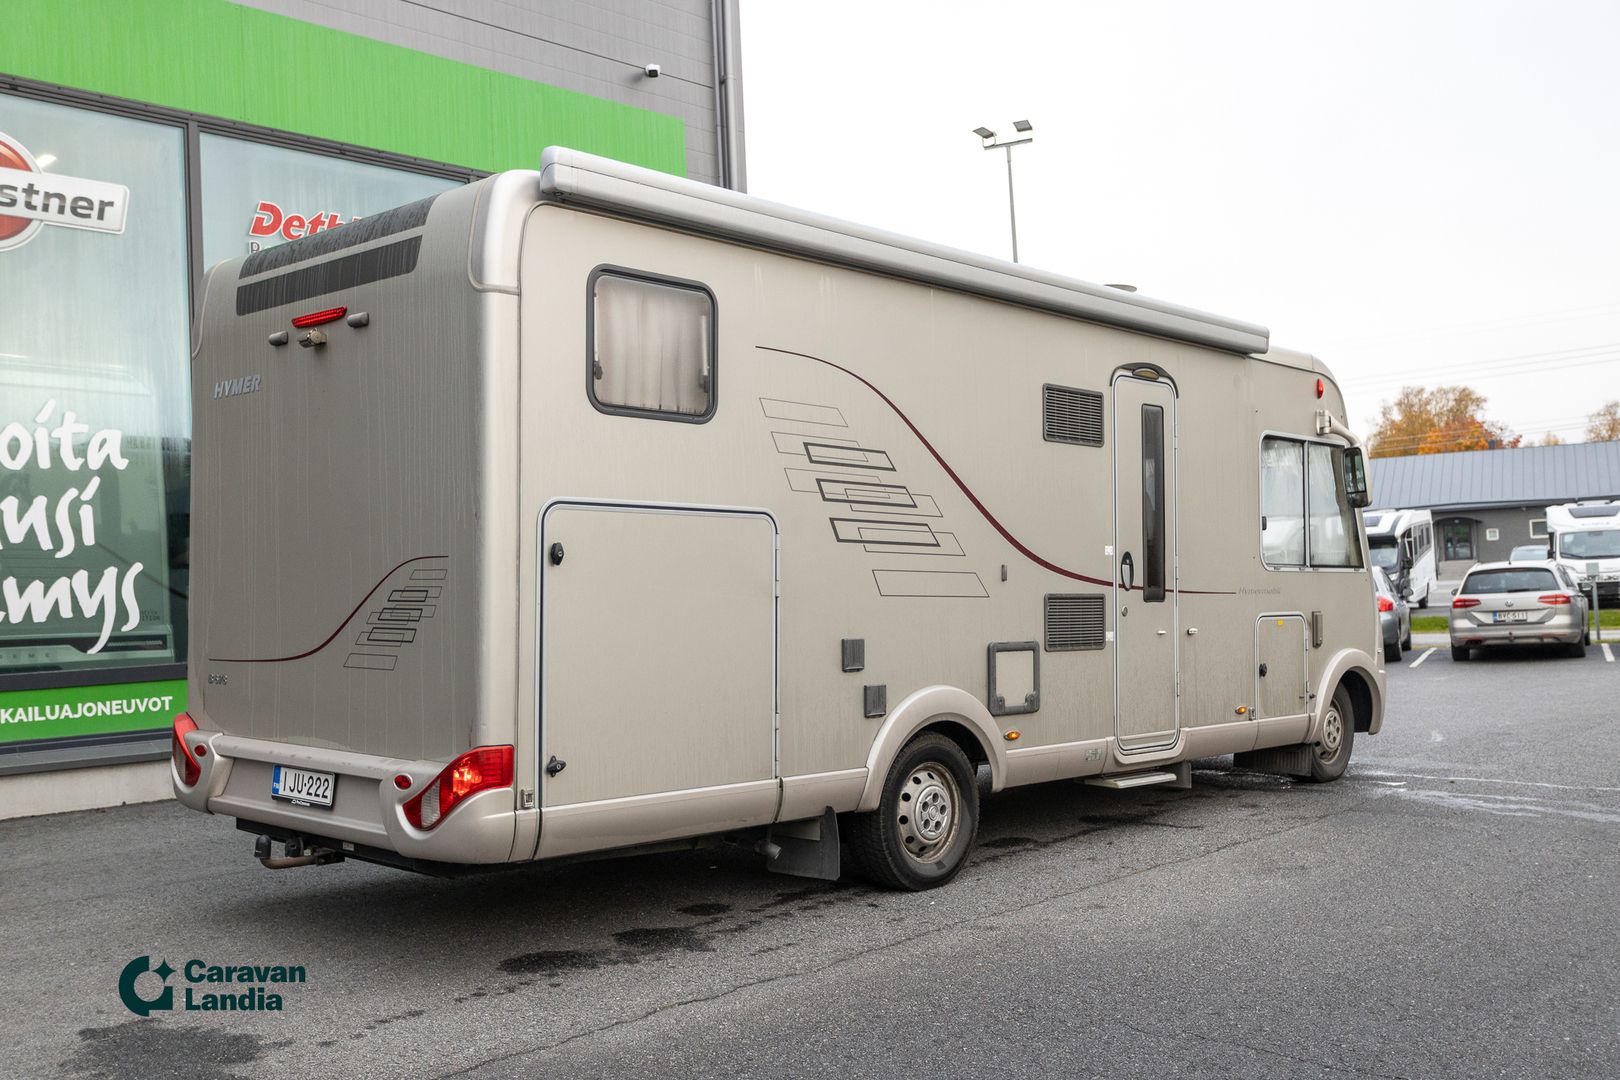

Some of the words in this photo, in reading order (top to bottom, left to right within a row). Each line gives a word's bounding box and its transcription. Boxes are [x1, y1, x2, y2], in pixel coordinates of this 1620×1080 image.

[214, 375, 261, 400] HYMER
[0, 476, 100, 559] usi
[0, 562, 144, 655] mys
[0, 696, 173, 724] KAILUAJONEUVOT
